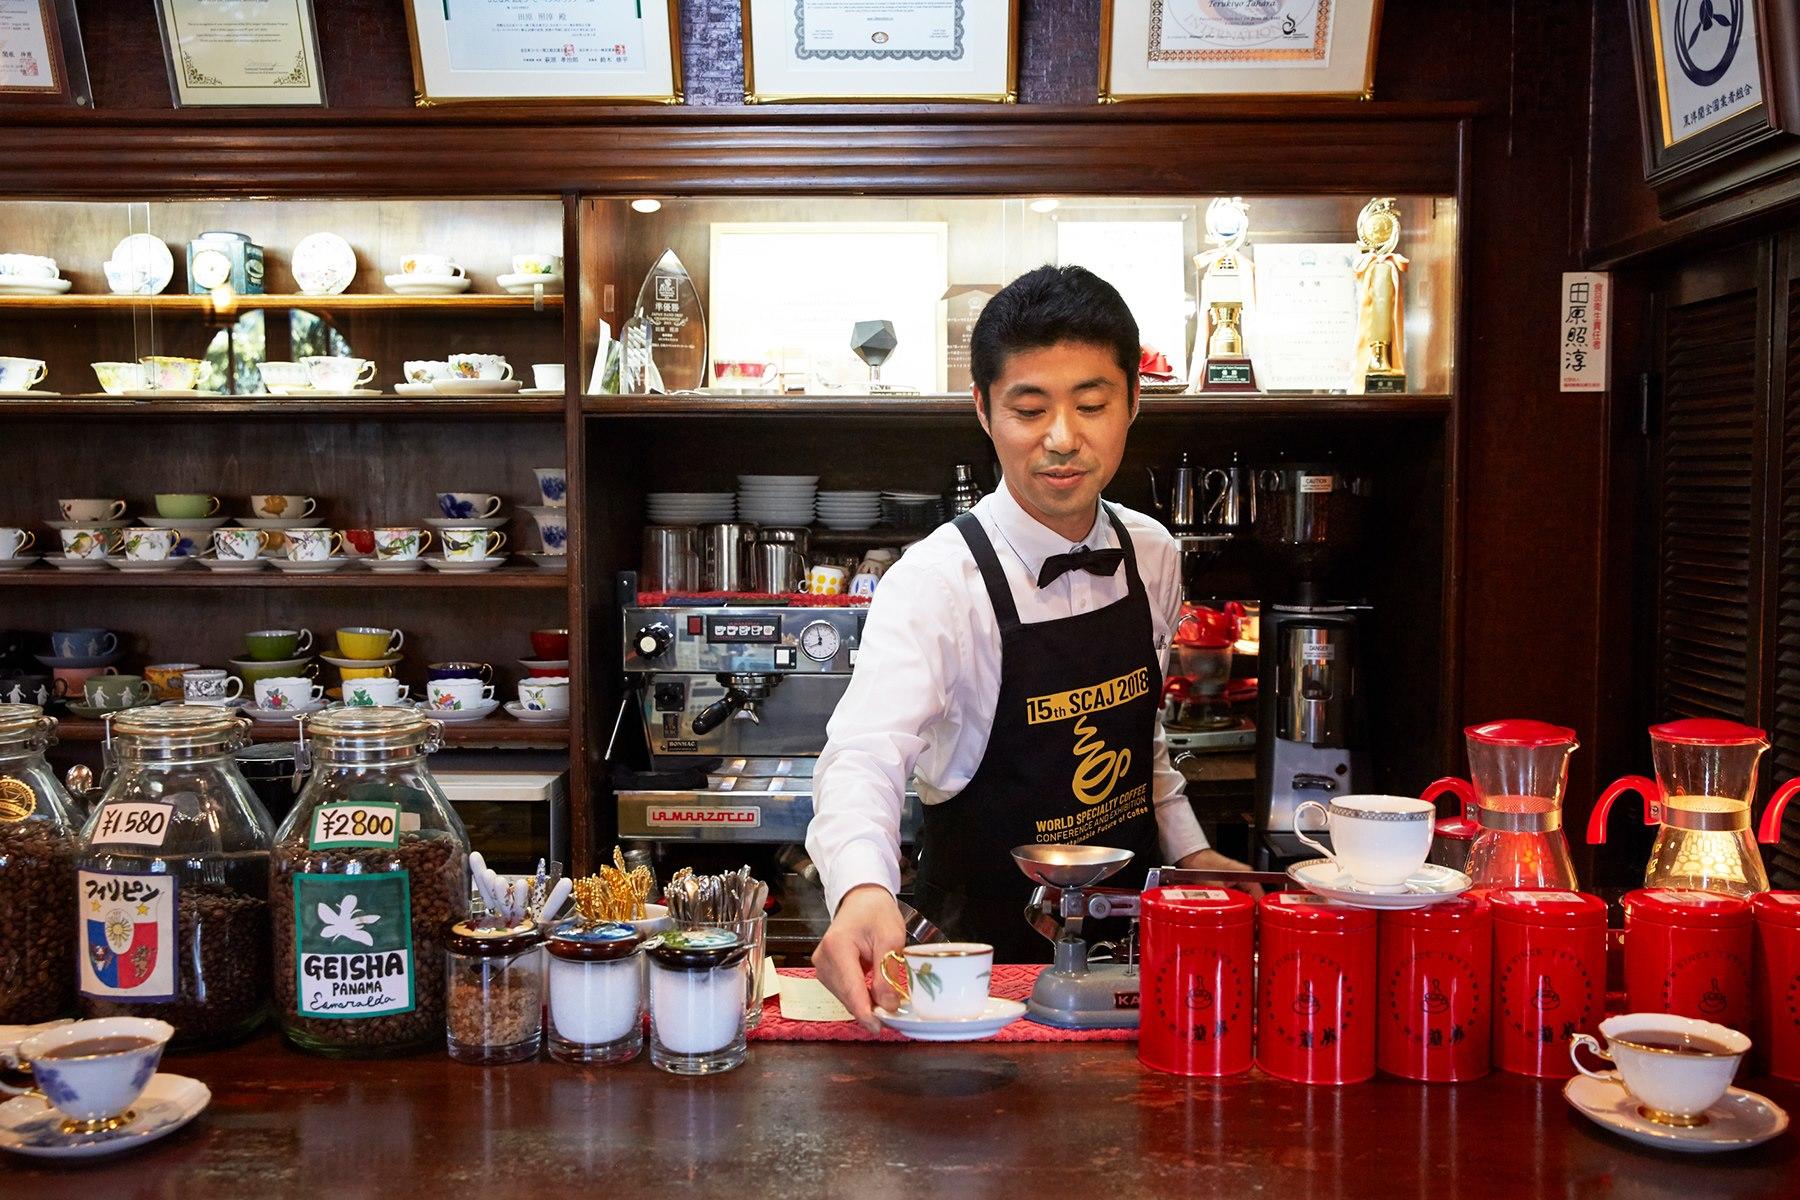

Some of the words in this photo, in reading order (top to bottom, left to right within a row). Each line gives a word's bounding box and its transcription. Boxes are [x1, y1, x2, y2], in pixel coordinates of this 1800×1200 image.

[1565, 282, 1589, 372] 田原照淳
[1027, 698, 1067, 722] 15th
[1068, 683, 1115, 715] SCAJ
[1117, 669, 1149, 702] 2018
[1036, 815, 1074, 833] WORLD
[1076, 796, 1119, 825] SPECIALTY
[1119, 783, 1148, 804] COFFEE
[1036, 821, 1093, 843] CONFERENCE
[1093, 814, 1109, 827] AND
[1109, 796, 1146, 820] EXHIBITION
[1126, 806, 1149, 819] Coffee
[85, 879, 160, 902] フィリピン
[304, 953, 404, 980] GEISHA
[310, 991, 396, 1011] Esmeralda
[332, 981, 383, 997] PANAMA
